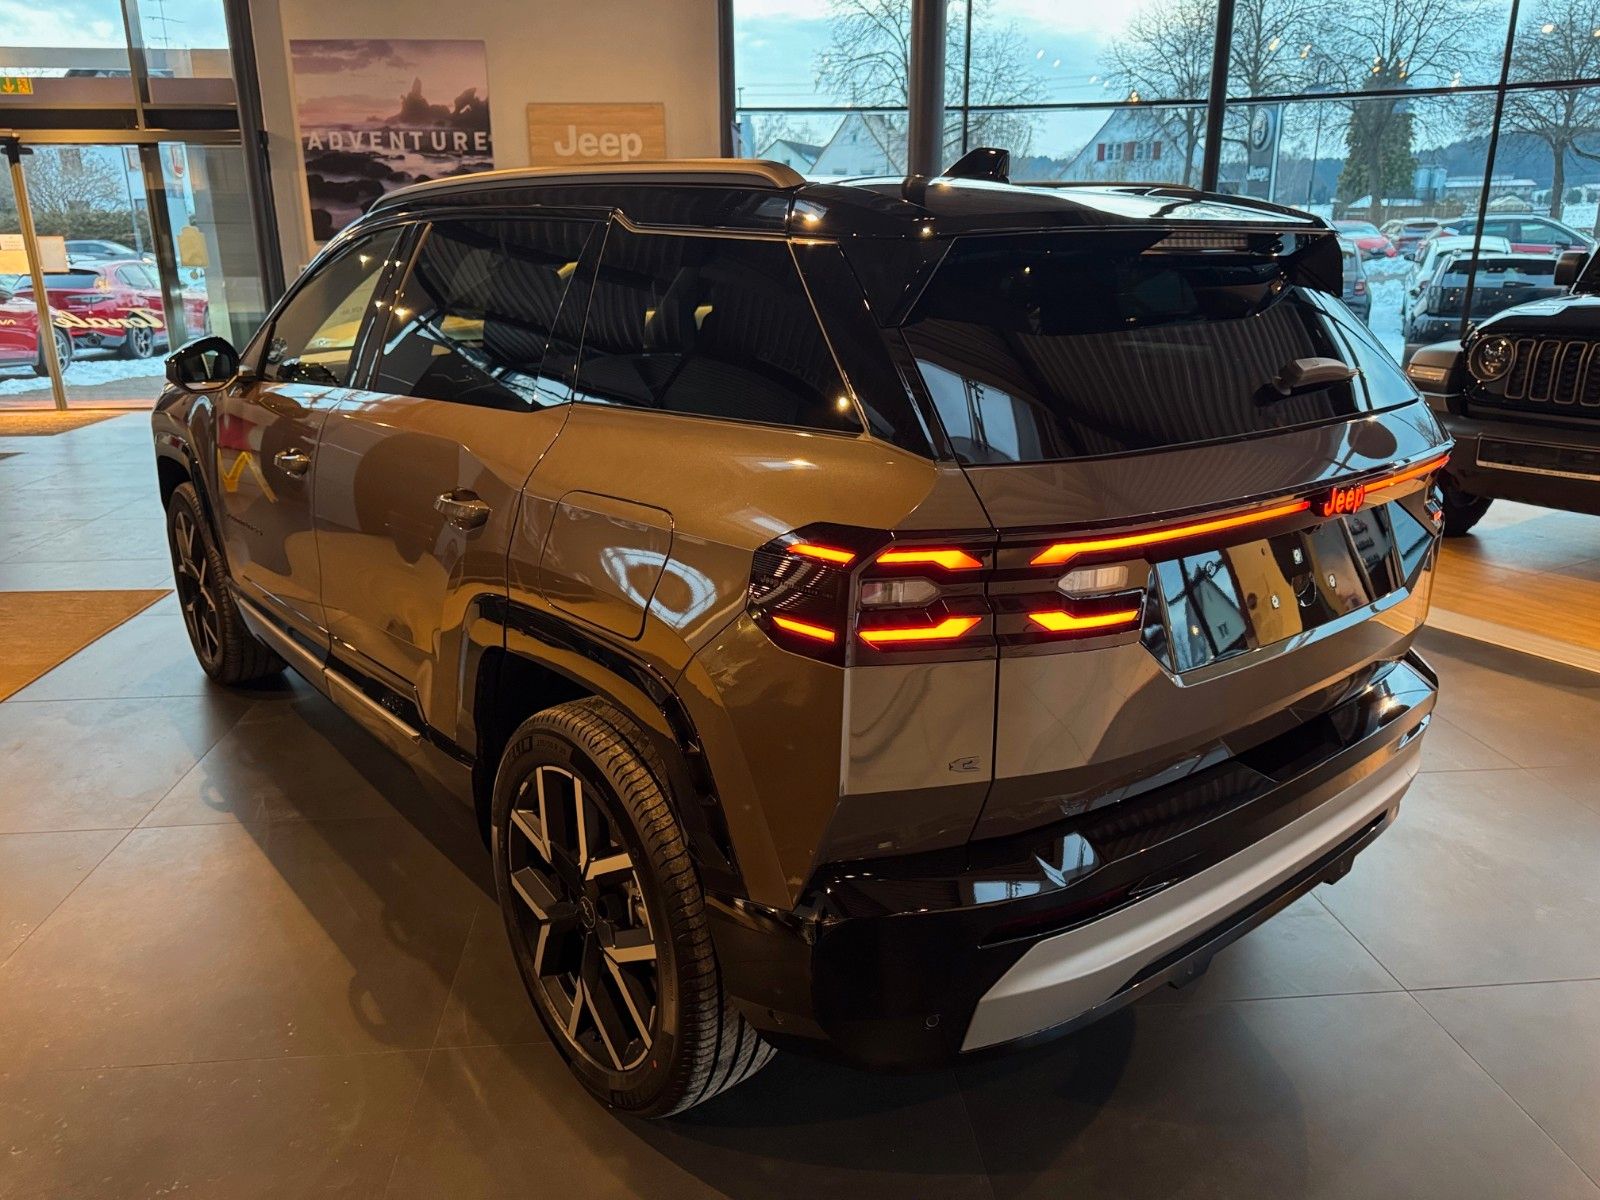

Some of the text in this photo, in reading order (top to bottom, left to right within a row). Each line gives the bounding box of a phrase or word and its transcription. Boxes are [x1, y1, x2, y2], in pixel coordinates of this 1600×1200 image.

[307, 131, 488, 152] ADVENTURE
[553, 124, 643, 162] Jeep
[1323, 484, 1364, 517] Jeep
